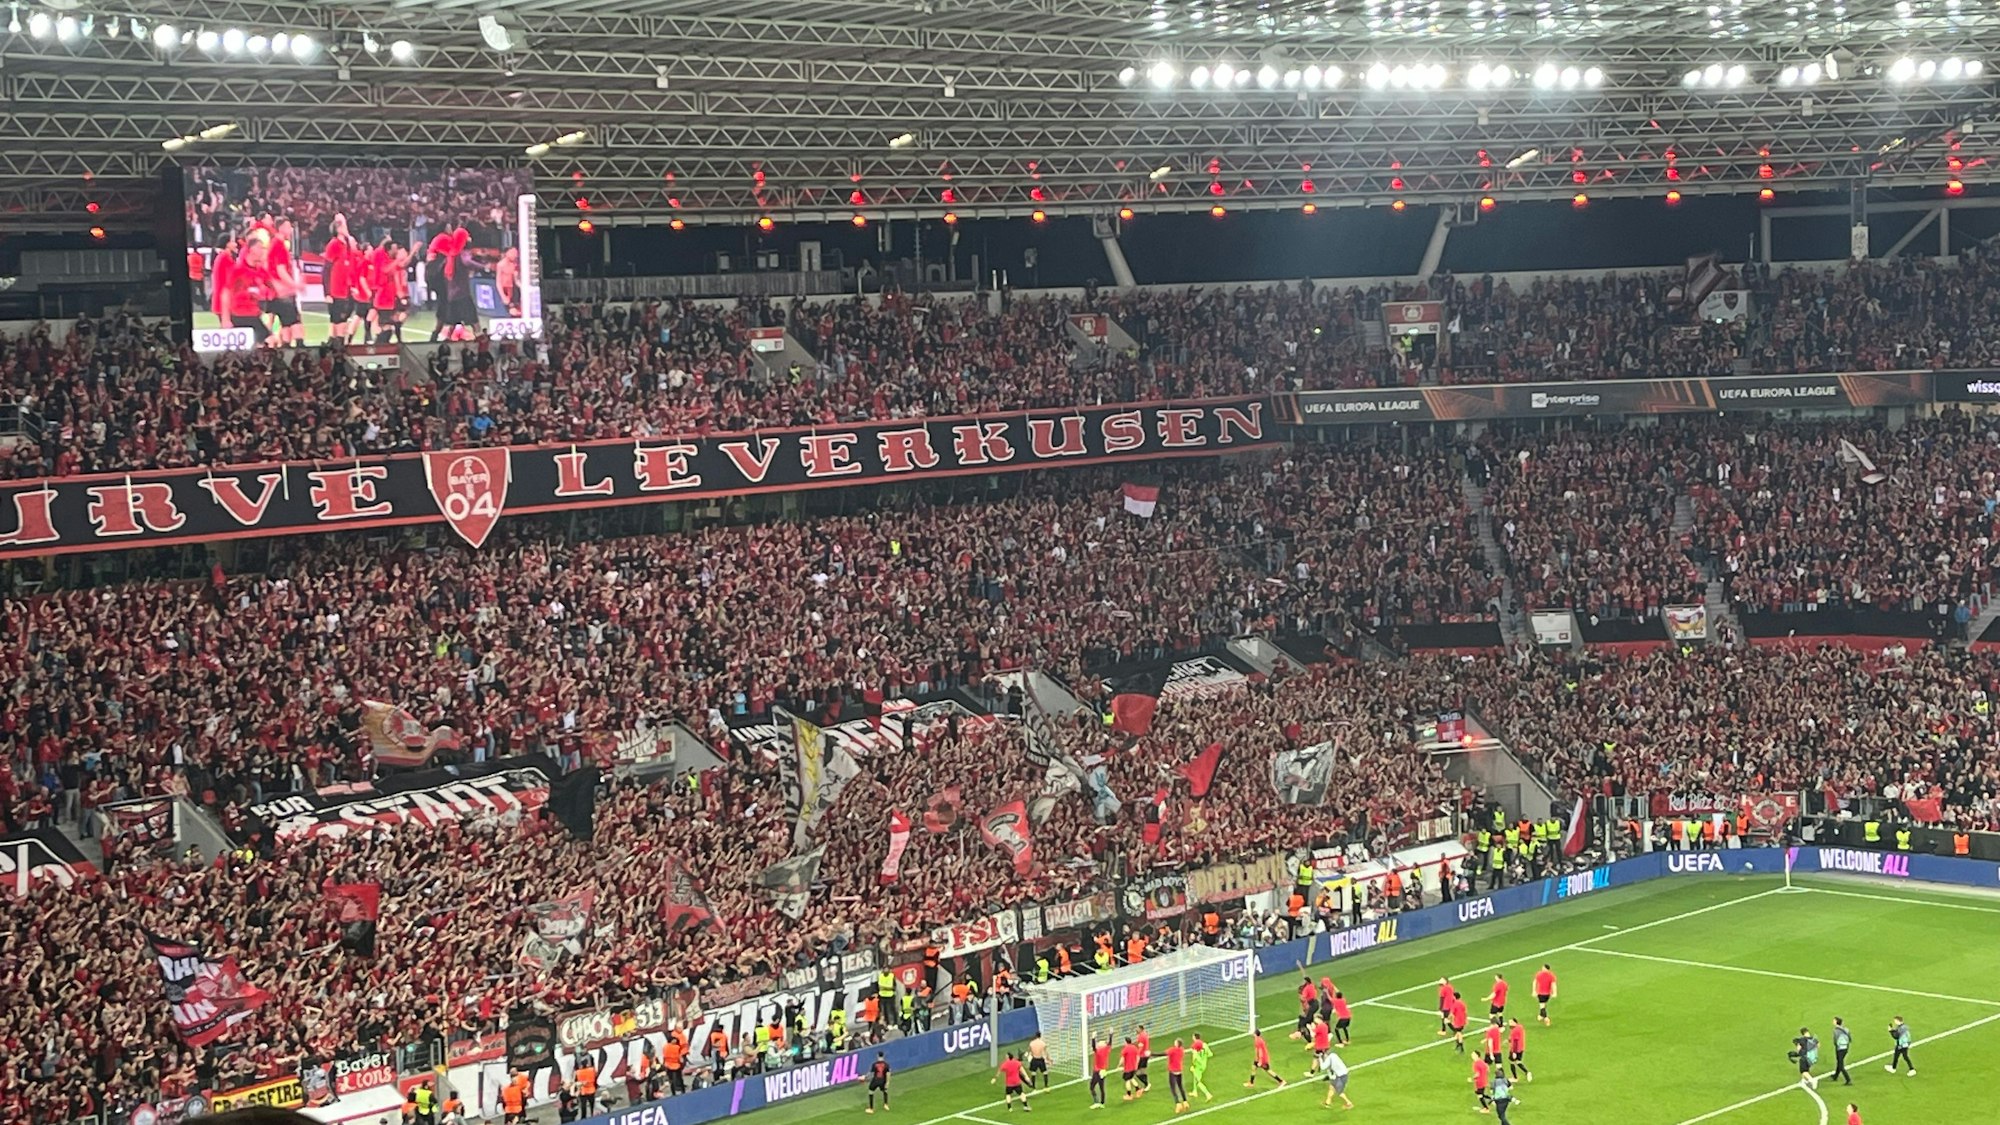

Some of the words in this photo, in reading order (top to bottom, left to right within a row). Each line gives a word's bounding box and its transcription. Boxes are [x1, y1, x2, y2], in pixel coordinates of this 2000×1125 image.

[201, 331, 247, 348] 90:00
[1719, 388, 1748, 399] UEFA
[1750, 386, 1792, 399] EUROPA
[1794, 385, 1837, 397] LEAGUE
[1304, 403, 1334, 414] UEFA
[1335, 401, 1377, 413] EUROPA
[1378, 400, 1420, 411] LEAGUE
[553, 402, 1264, 496] LEVERKUSEN
[444, 491, 497, 521] 04
[1667, 852, 1724, 873] UEFA
[1818, 848, 1882, 874] WELCOME
[1882, 854, 1910, 877] ALL
[1557, 866, 1611, 899] #FOOTBALL
[1458, 897, 1495, 922] UEFA
[1330, 923, 1377, 957] WELCOME
[1377, 919, 1398, 943] ALL
[1221, 955, 1264, 982] UEFA
[943, 1022, 992, 1053] UEFA
[336, 1052, 391, 1077] Bayer
[763, 1060, 831, 1103] WELCOME
[830, 1053, 859, 1086] ALL
